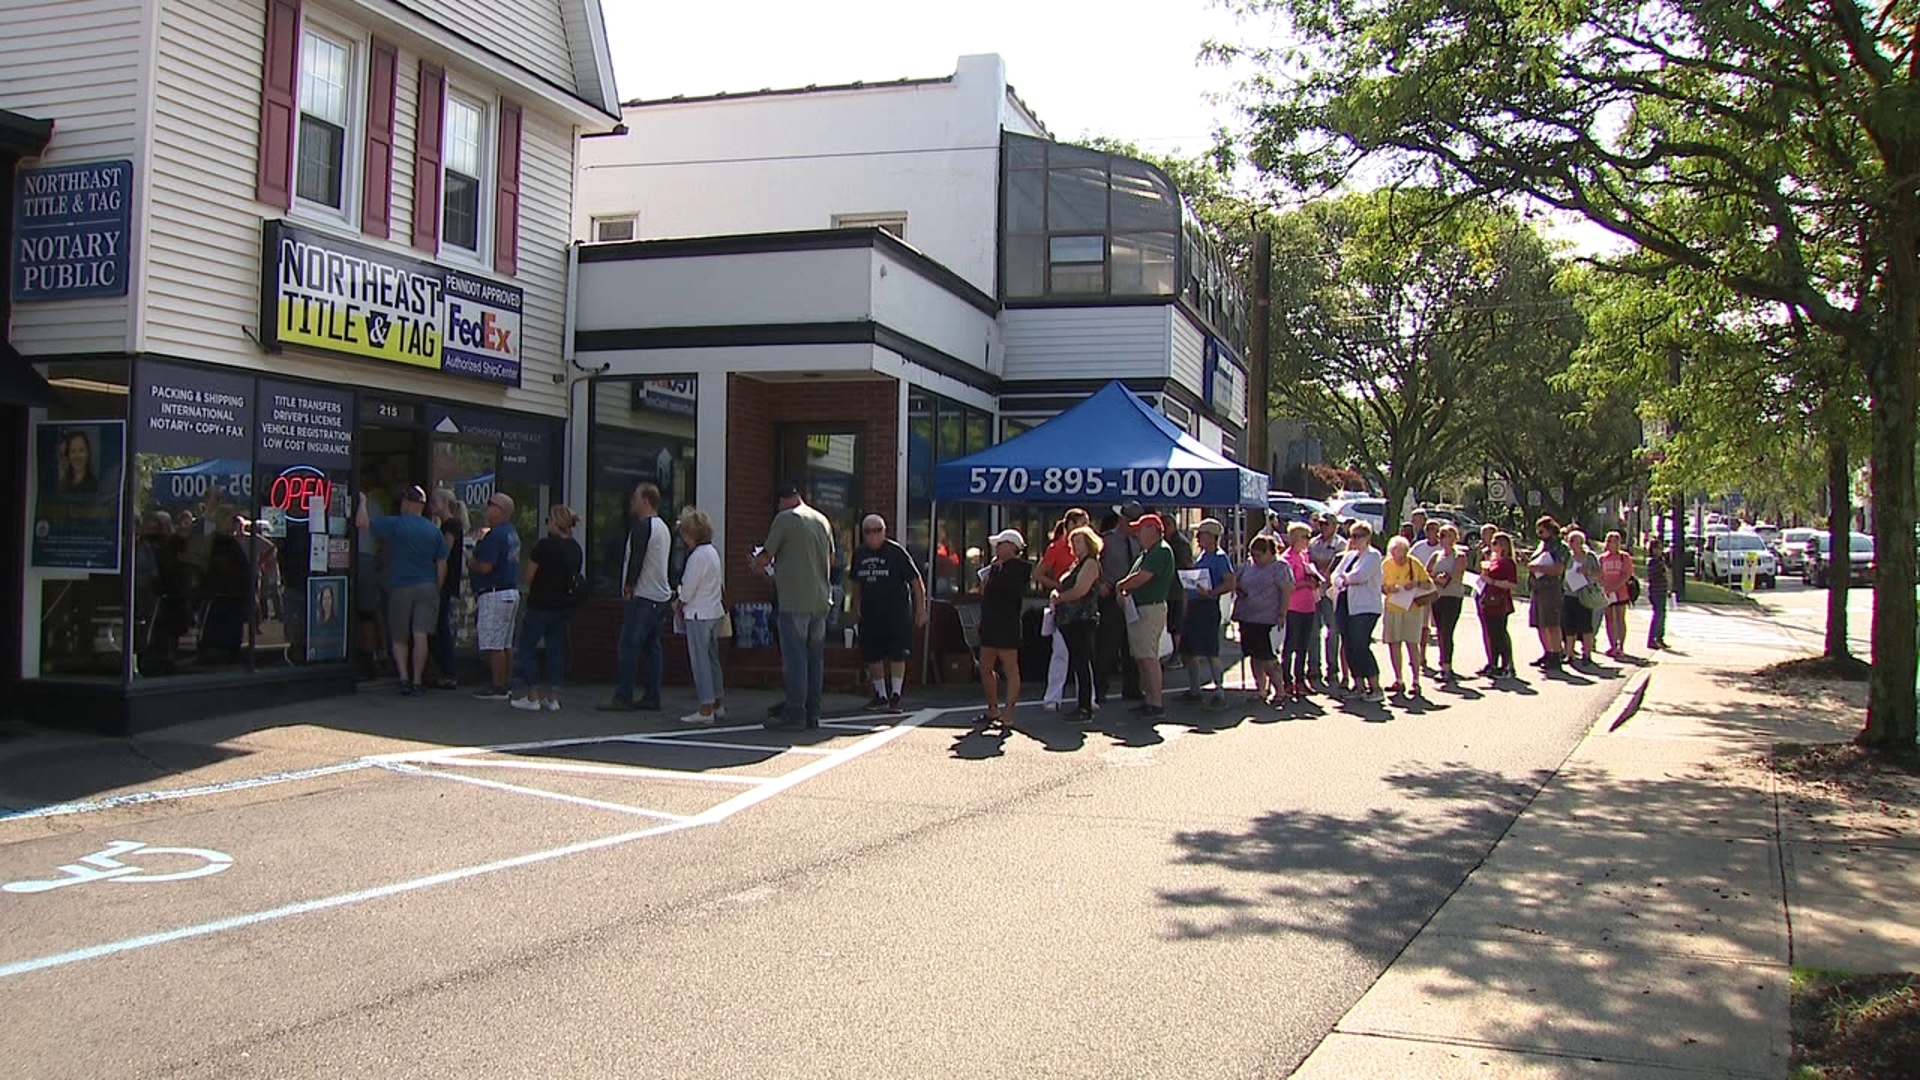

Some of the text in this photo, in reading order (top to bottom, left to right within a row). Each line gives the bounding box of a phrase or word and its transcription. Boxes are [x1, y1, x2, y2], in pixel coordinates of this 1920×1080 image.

[25, 168, 121, 194] NORTHEAST
[24, 190, 121, 216] TITLE & TAG
[21, 231, 120, 262] NOTARY
[23, 261, 115, 291] PUBLIC
[282, 239, 440, 318] NORTHEAST
[446, 274, 520, 308] PENNDOT APPROVED
[283, 290, 436, 358] TITLE & TAG
[448, 302, 511, 354] FedEx
[445, 354, 518, 379] Authorized ShipCenter
[151, 385, 244, 407] PACKING & SHIPPING
[274, 395, 342, 413] TITLE TRANSFERS
[161, 402, 234, 421] INTERNATIONAL
[273, 409, 342, 427] DRIVER'S LICENSE
[379, 404, 398, 417] 215
[226, 425, 244, 438] FAX
[261, 422, 351, 442] VEHICLE REGISTRATION
[263, 437, 349, 455] LOW COST INSURANCE
[270, 476, 333, 511] OPEN
[969, 467, 1203, 497] 570-895-1000
